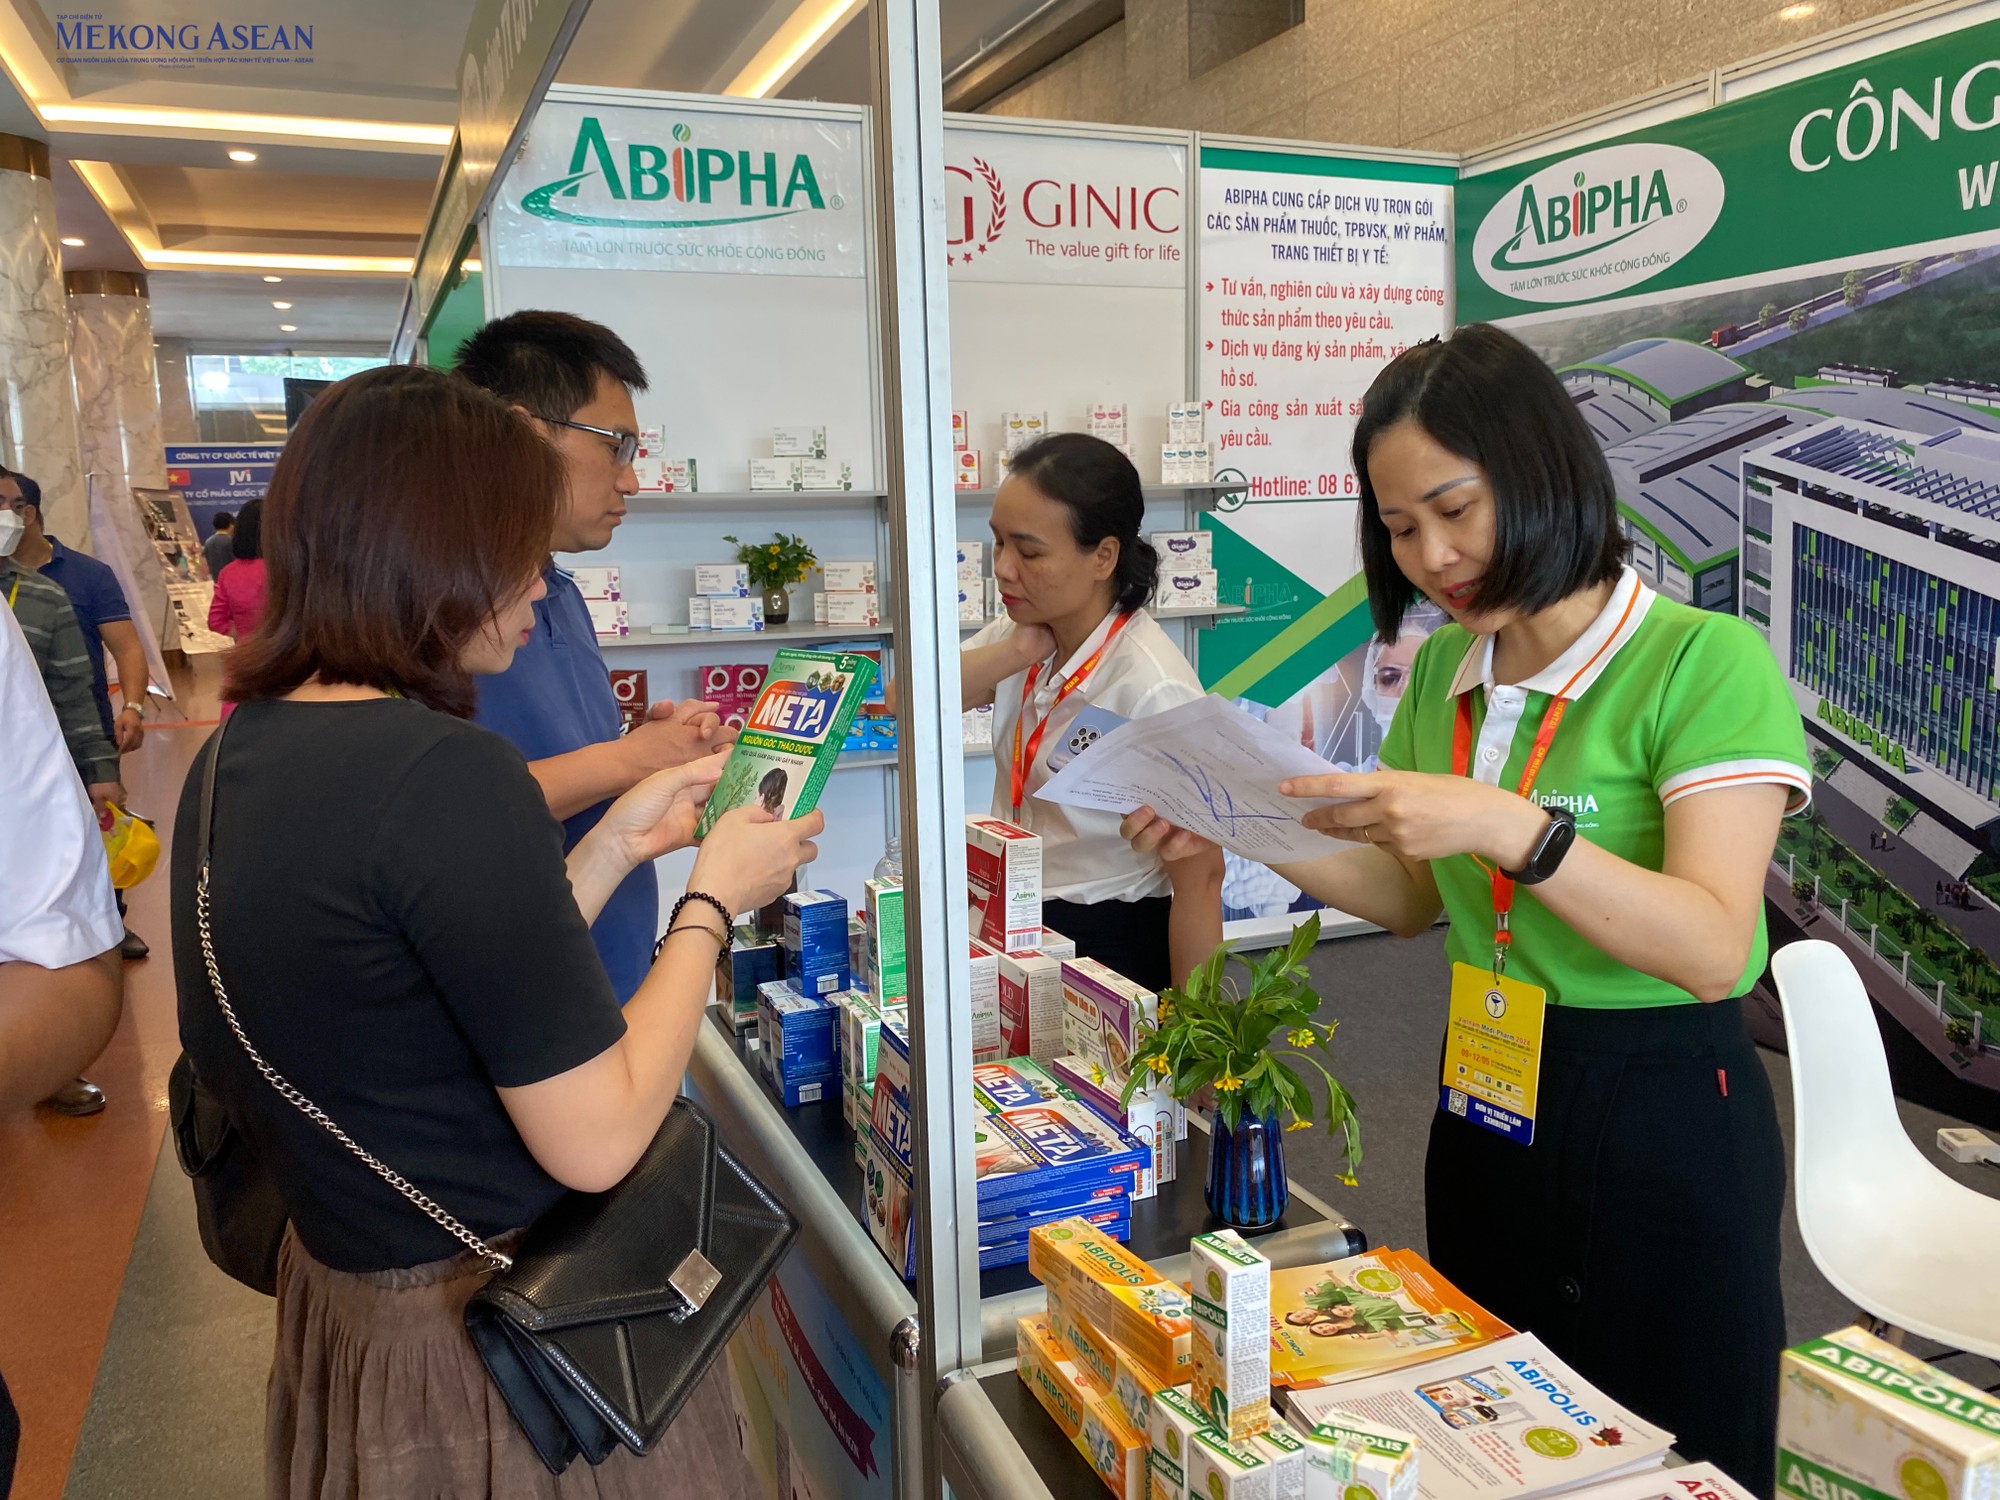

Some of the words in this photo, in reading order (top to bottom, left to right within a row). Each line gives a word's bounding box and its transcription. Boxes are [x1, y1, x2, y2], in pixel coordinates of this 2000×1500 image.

[562, 116, 826, 209] ABIPHA
[1022, 179, 1179, 233] GINIC
[1225, 188, 1267, 206] ABIPHA
[1272, 191, 1303, 208] CUNG
[1308, 188, 1330, 210] CẤP
[1334, 194, 1360, 215] DỊCH
[1364, 197, 1379, 216] VỤ
[1383, 198, 1411, 218] TRỌN
[1415, 197, 1433, 216] GÓI
[1512, 169, 1672, 250] ABIPHA
[1207, 212, 1231, 231] CÁC
[1236, 213, 1259, 232] SẢN
[1263, 212, 1296, 235] PHẨM
[1301, 215, 1341, 238] THUỐC,
[1345, 221, 1390, 240] TPBVSK,
[1394, 222, 1410, 241] MỸ
[1414, 220, 1448, 243] PHẨM,
[746, 245, 784, 261] CỘNG
[787, 246, 826, 262] ĐỒNG
[1025, 239, 1055, 256] The
[1060, 241, 1100, 258] value
[1105, 243, 1129, 262] gift
[1133, 244, 1154, 260] for
[1159, 245, 1180, 261] life
[1272, 244, 1309, 261] TRANG
[1313, 243, 1343, 263] THIẾT
[1347, 248, 1358, 267] BỊ
[1362, 249, 1370, 264] Y
[1374, 246, 1389, 265] TẾ:
[1572, 267, 1588, 282] SỨC
[1614, 258, 1641, 273] CỘNG
[1642, 252, 1671, 268] ĐỒNG
[1221, 277, 1237, 296] Tư
[1241, 276, 1267, 299] vấn,
[1271, 280, 1312, 301] nghiên
[1316, 281, 1337, 299] cứu
[1341, 284, 1355, 299] và
[1359, 285, 1380, 303] xây
[1383, 285, 1412, 305] dựng
[1416, 287, 1444, 305] công
[1221, 309, 1250, 327] thức
[1252, 308, 1275, 327] sản
[1278, 307, 1312, 331] phẩm
[1315, 312, 1342, 328] theo
[1345, 313, 1367, 332] yêu
[1369, 310, 1394, 330] cầu.
[1221, 339, 1249, 360] Dịch
[1253, 342, 1267, 359] vụ
[1272, 341, 1303, 360] đăng
[1306, 340, 1321, 361] ký
[1324, 340, 1346, 358] sản
[1350, 339, 1386, 361] phẩm,
[1221, 368, 1236, 387] hồ
[1239, 370, 1257, 387] sơ.
[1221, 399, 1241, 417] Gia
[1248, 400, 1279, 420] công
[1286, 398, 1308, 417] sản
[1315, 397, 1342, 416] xuất
[1220, 430, 1243, 450] yêu
[1246, 427, 1272, 447] cầu.
[176, 452, 199, 460] CÔNG
[201, 452, 210, 460] TY
[1252, 473, 1312, 497] Hotline:
[1318, 473, 1337, 495] 08
[839, 656, 849, 670] 5
[755, 693, 826, 734] META
[742, 735, 763, 746] NGUỒN
[763, 738, 777, 748] GỐC
[778, 741, 794, 752] THẢO
[795, 744, 814, 756] DƯỢC
[1816, 697, 1906, 774] ABIPHA
[1458, 1016, 1480, 1028] Vietnam
[1481, 1023, 1515, 1041] Medi-Pharm
[1516, 1036, 1531, 1046] 2024
[974, 1067, 1032, 1106] META
[1007, 1112, 1083, 1160] META
[1078, 1241, 1144, 1285] ABIPOLIS
[1193, 1301, 1226, 1327] ABIPOLIS
[1067, 1325, 1111, 1385] ABIPOLIS
[1036, 1367, 1078, 1428] ABIPOLIS
[1464, 1376, 1503, 1400] ABIPOLIS
[1506, 1360, 1597, 1427] ABIPOLIS
[1811, 1347, 2000, 1430] ABIPOLIS
[1201, 1431, 1257, 1465] ABIPOLIS
[1319, 1427, 1402, 1452] ABIPOLIS
[1152, 1453, 1183, 1483] ABIPOLIS
